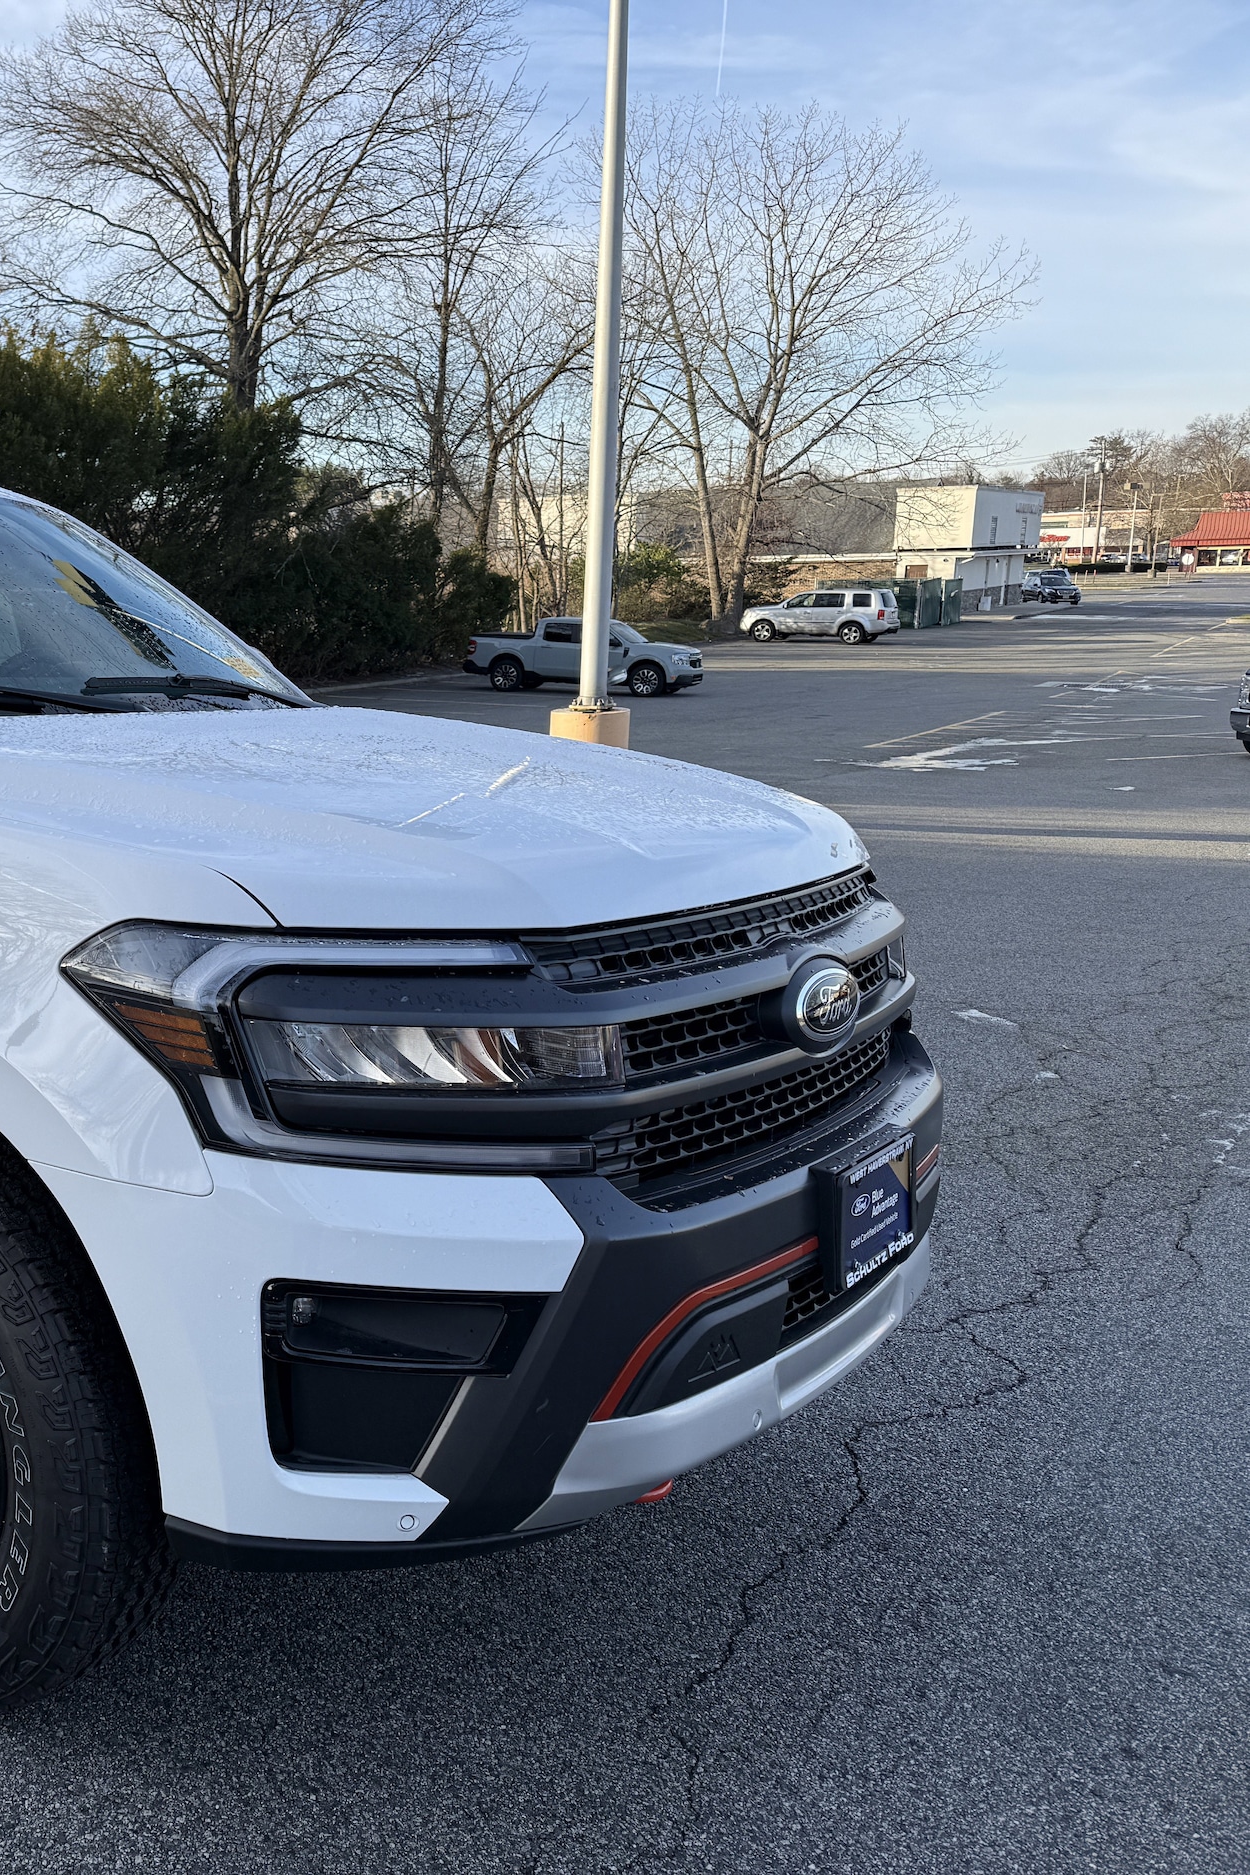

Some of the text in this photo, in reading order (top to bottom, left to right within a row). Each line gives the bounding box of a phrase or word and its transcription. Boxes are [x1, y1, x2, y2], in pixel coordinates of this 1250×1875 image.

[819, 983, 852, 1027] Ford
[850, 1166, 868, 1185] WEST
[871, 1188, 884, 1204] Blue
[871, 1192, 899, 1218] Advantage
[850, 1211, 899, 1249] Gold Certified Used Vehicle
[846, 1232, 915, 1289] SCHULTZ FORD
